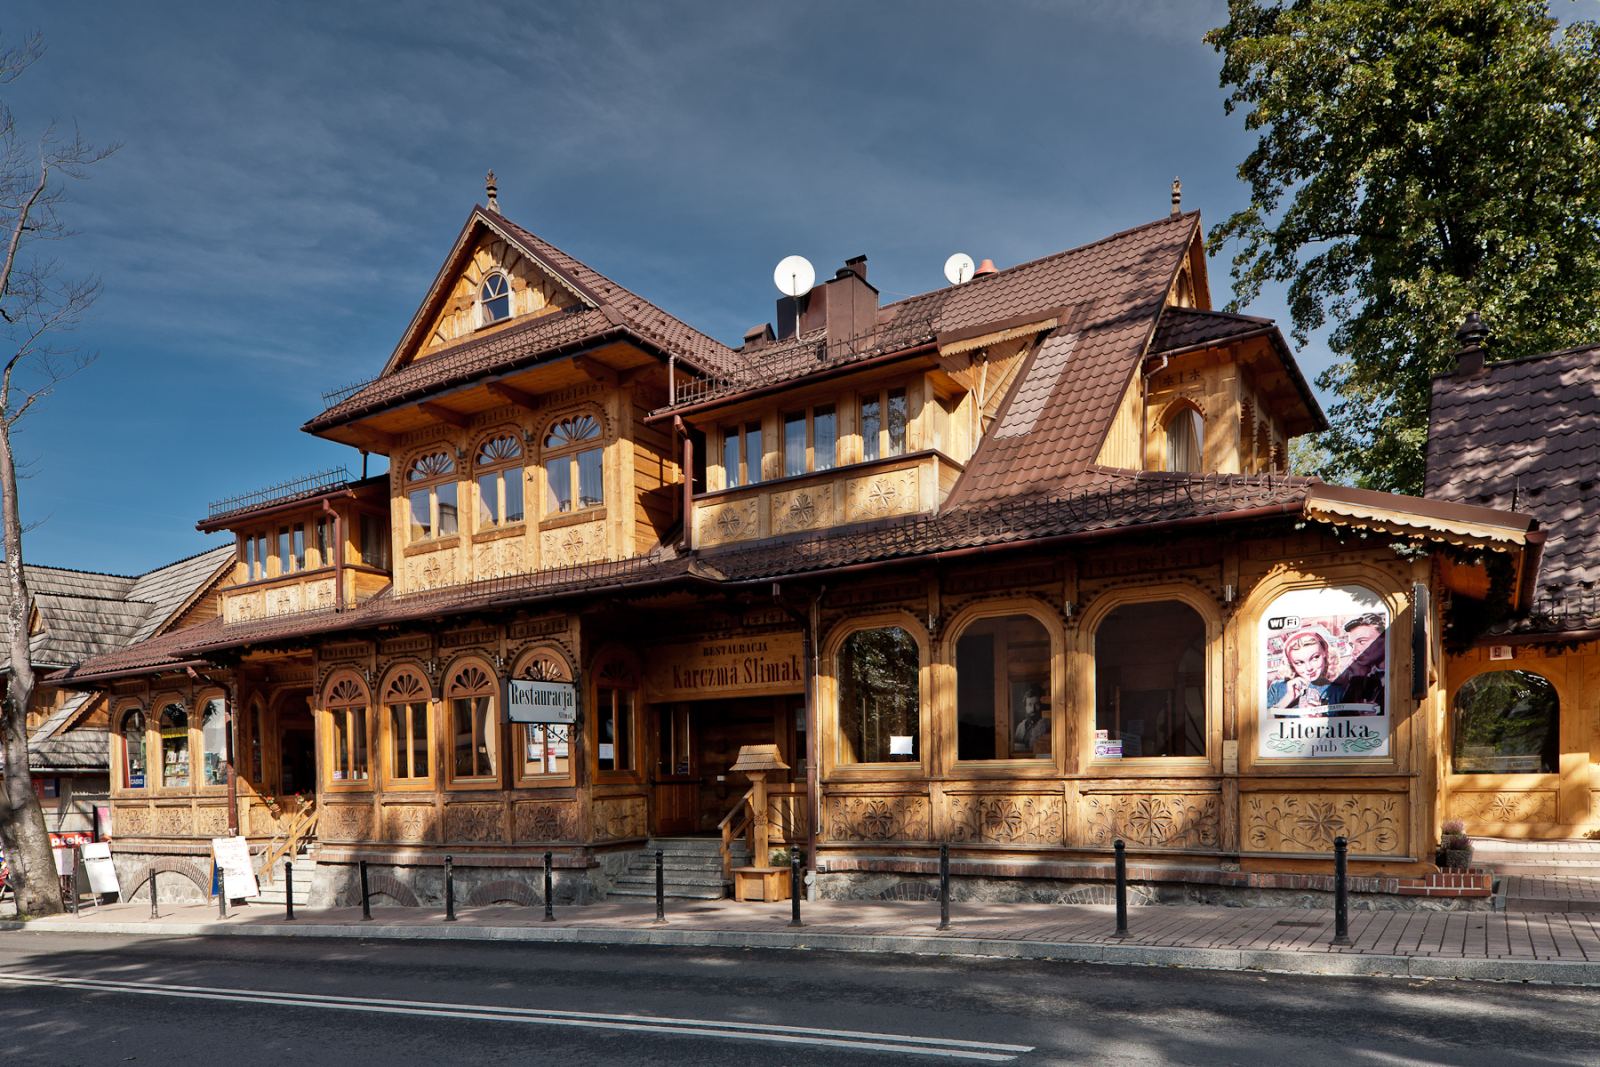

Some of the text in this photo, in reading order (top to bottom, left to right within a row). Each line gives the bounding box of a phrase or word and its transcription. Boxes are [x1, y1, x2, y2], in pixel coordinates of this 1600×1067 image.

[703, 641, 768, 657] RESTAURACJA
[672, 663, 738, 689] Karczma
[511, 683, 573, 710] Restauracja
[1279, 720, 1370, 739] Literatka
[1311, 740, 1337, 756] pub
